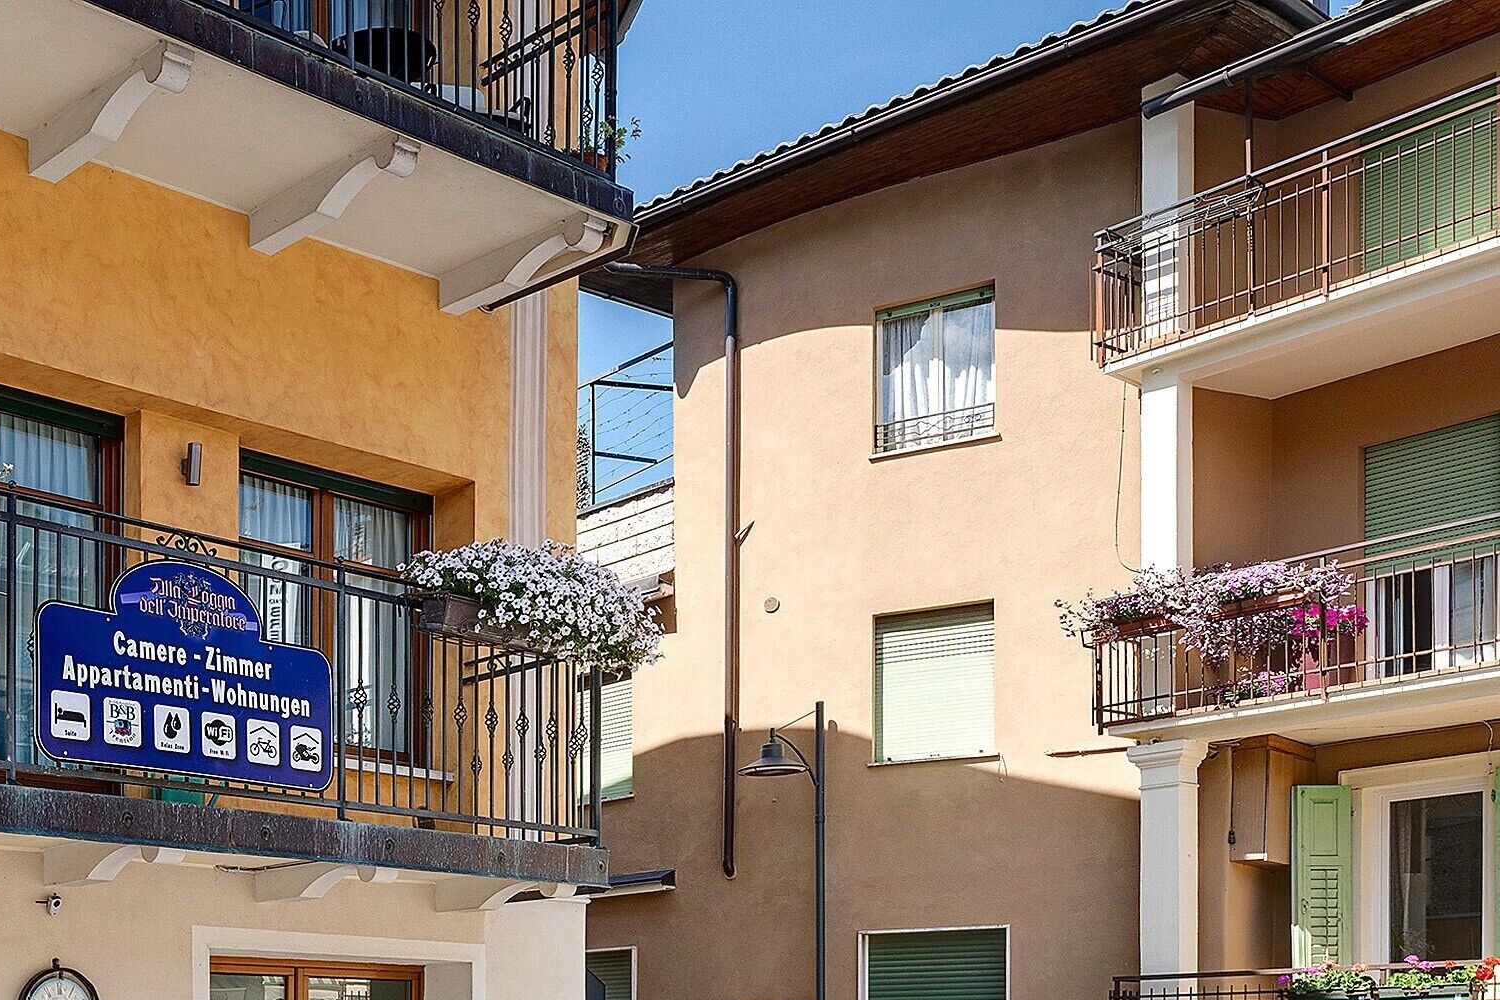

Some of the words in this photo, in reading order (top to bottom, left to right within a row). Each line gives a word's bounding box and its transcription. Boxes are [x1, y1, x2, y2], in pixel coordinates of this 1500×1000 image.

[150, 577, 181, 599] Alla
[113, 630, 187, 666] Camere
[205, 646, 272, 681] Zimmer
[110, 703, 136, 721] B&B
